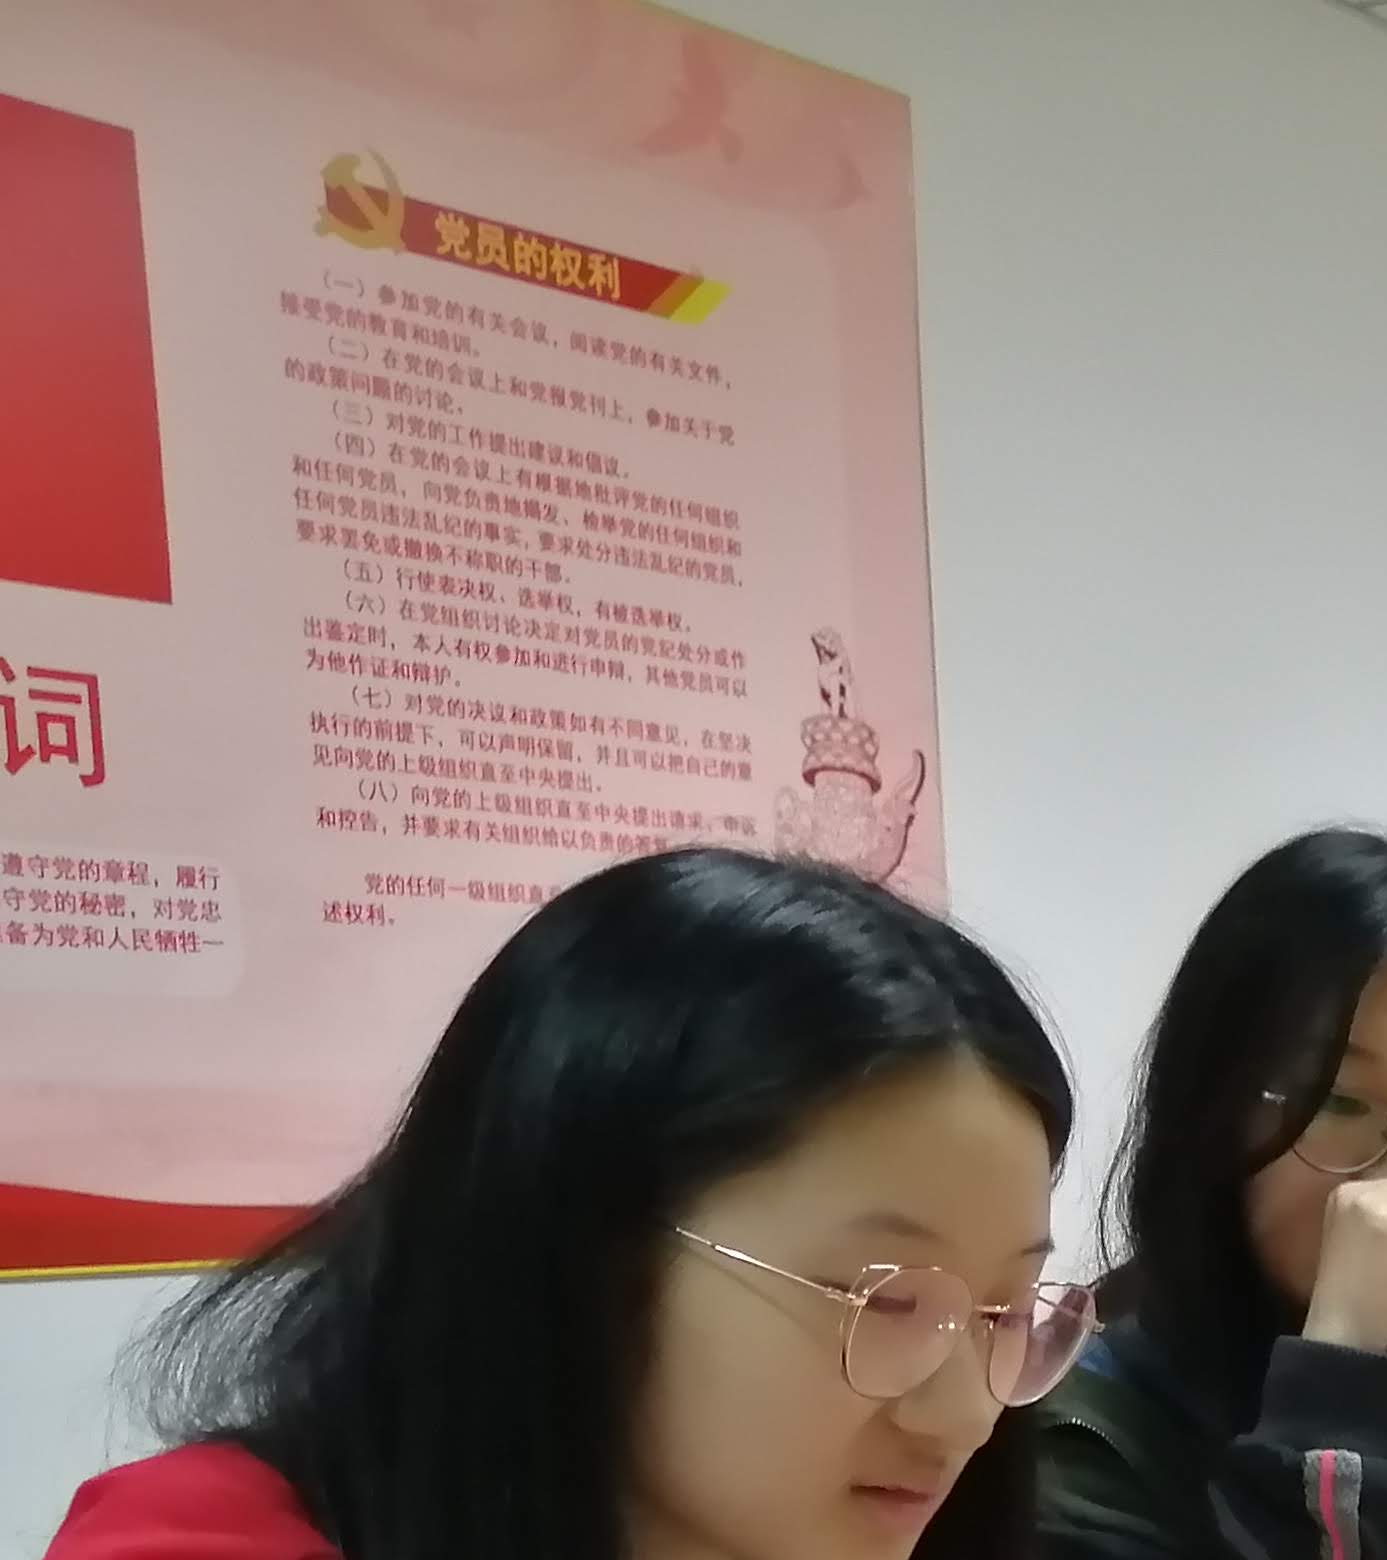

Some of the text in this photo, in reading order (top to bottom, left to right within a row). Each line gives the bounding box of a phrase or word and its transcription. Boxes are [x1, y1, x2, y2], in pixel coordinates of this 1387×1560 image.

[435, 210, 620, 300] 党员的权利
[0, 655, 105, 787] 词
[0, 920, 224, 954] 备为党和人民牺牲一
[322, 900, 395, 927] 述权利。
